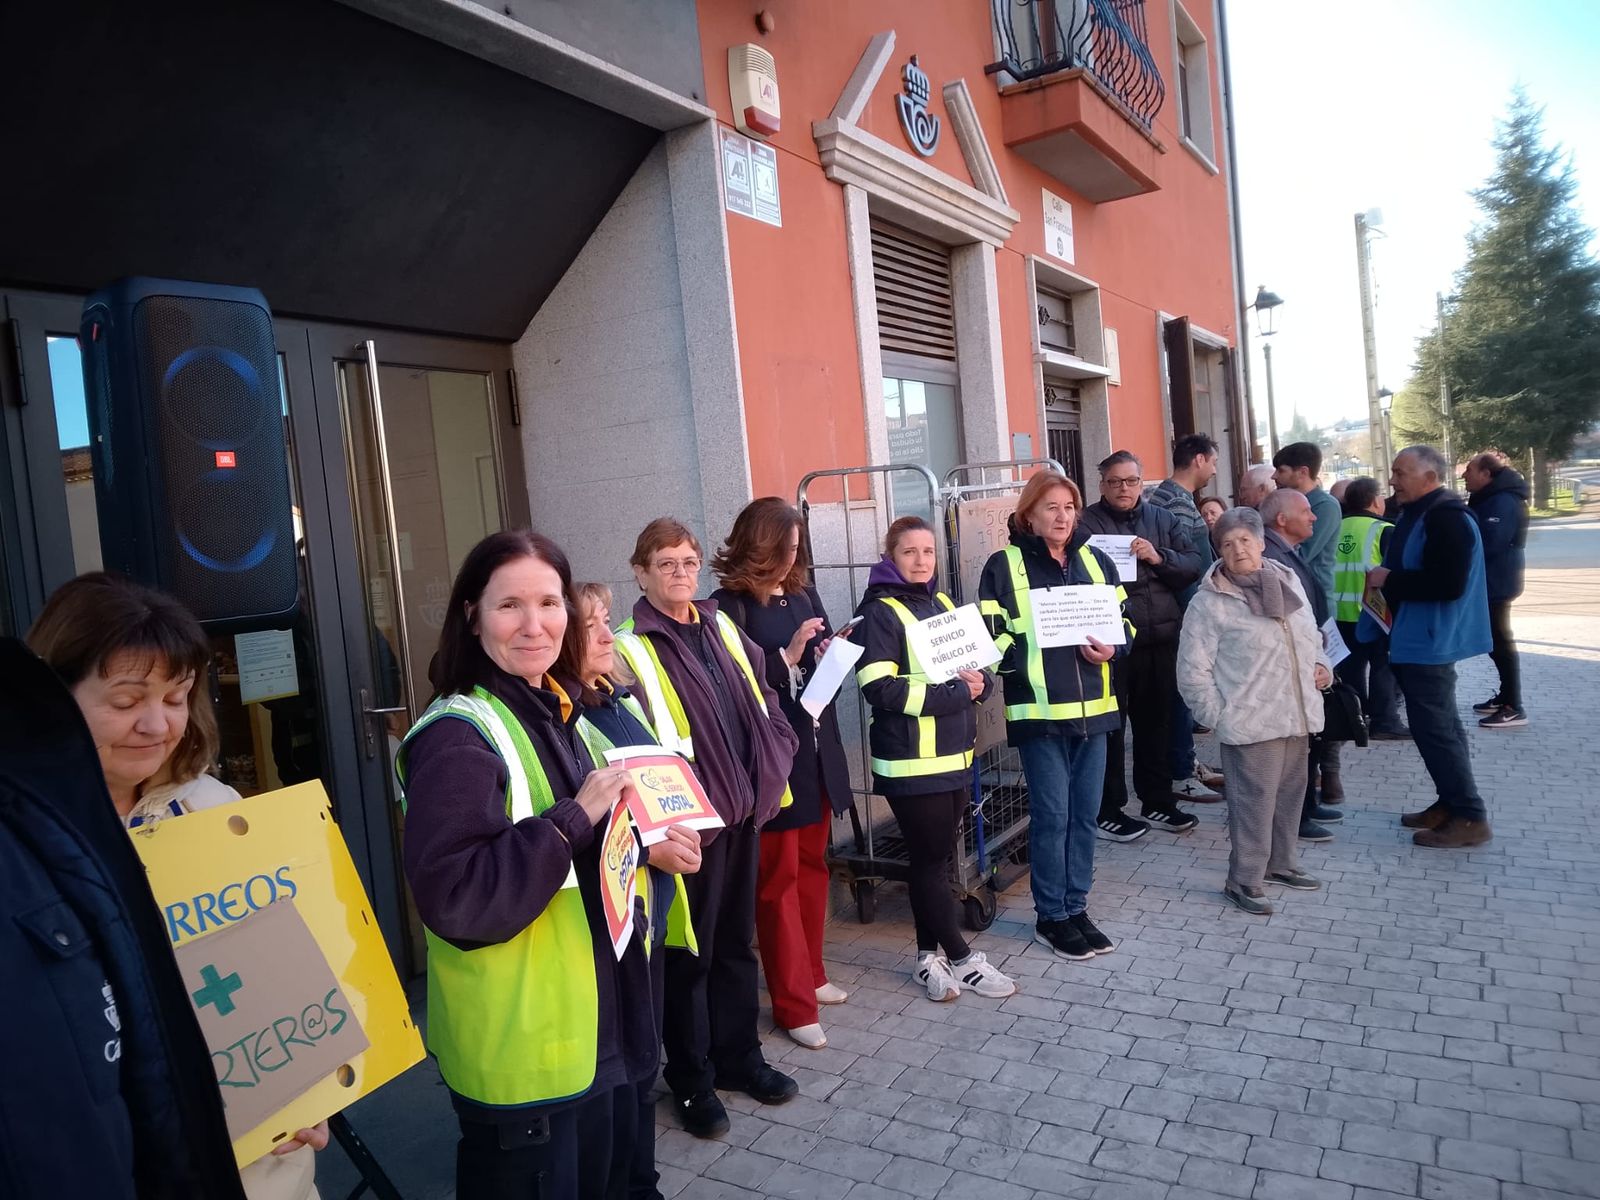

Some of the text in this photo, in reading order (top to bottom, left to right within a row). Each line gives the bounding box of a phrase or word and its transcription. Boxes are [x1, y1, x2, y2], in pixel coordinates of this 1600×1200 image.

[219, 455, 233, 464] JBL
[927, 613, 957, 631] POR UN
[930, 628, 966, 648] SERVICIO
[931, 642, 978, 666] PÚBLICO DE
[657, 794, 695, 815] POSTAL
[165, 865, 297, 942] RREOS
[210, 988, 347, 1089] RTER@S
